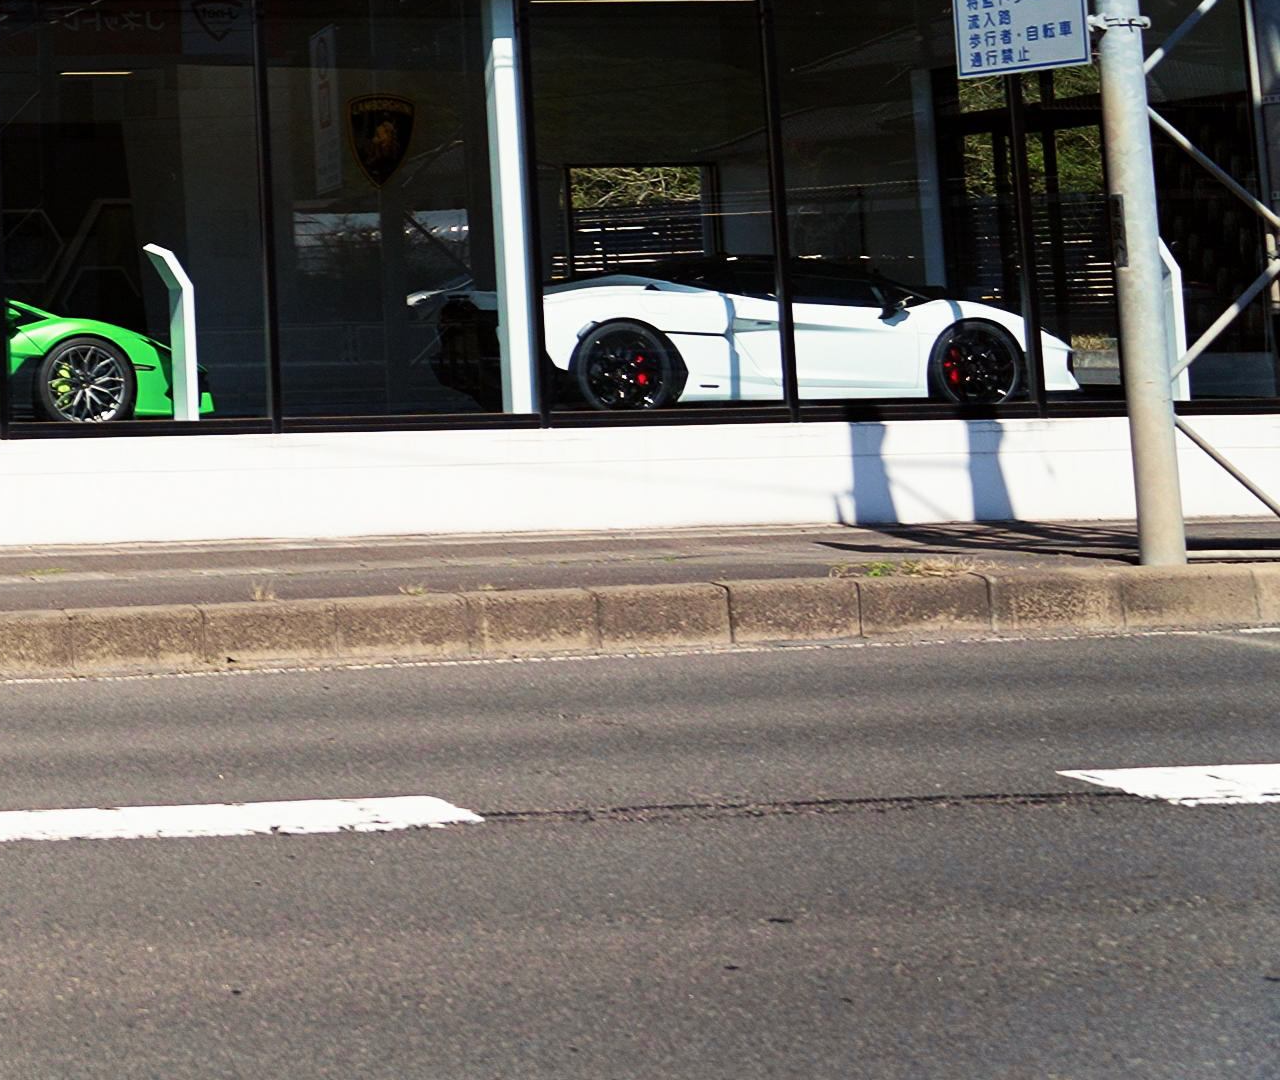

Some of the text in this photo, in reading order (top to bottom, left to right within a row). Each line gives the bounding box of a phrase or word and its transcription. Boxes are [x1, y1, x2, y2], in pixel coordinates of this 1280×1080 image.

[967, 9, 1011, 30] 流入路
[969, 21, 1072, 49] 歩行者・自転車
[970, 46, 1030, 68] 通行禁止
